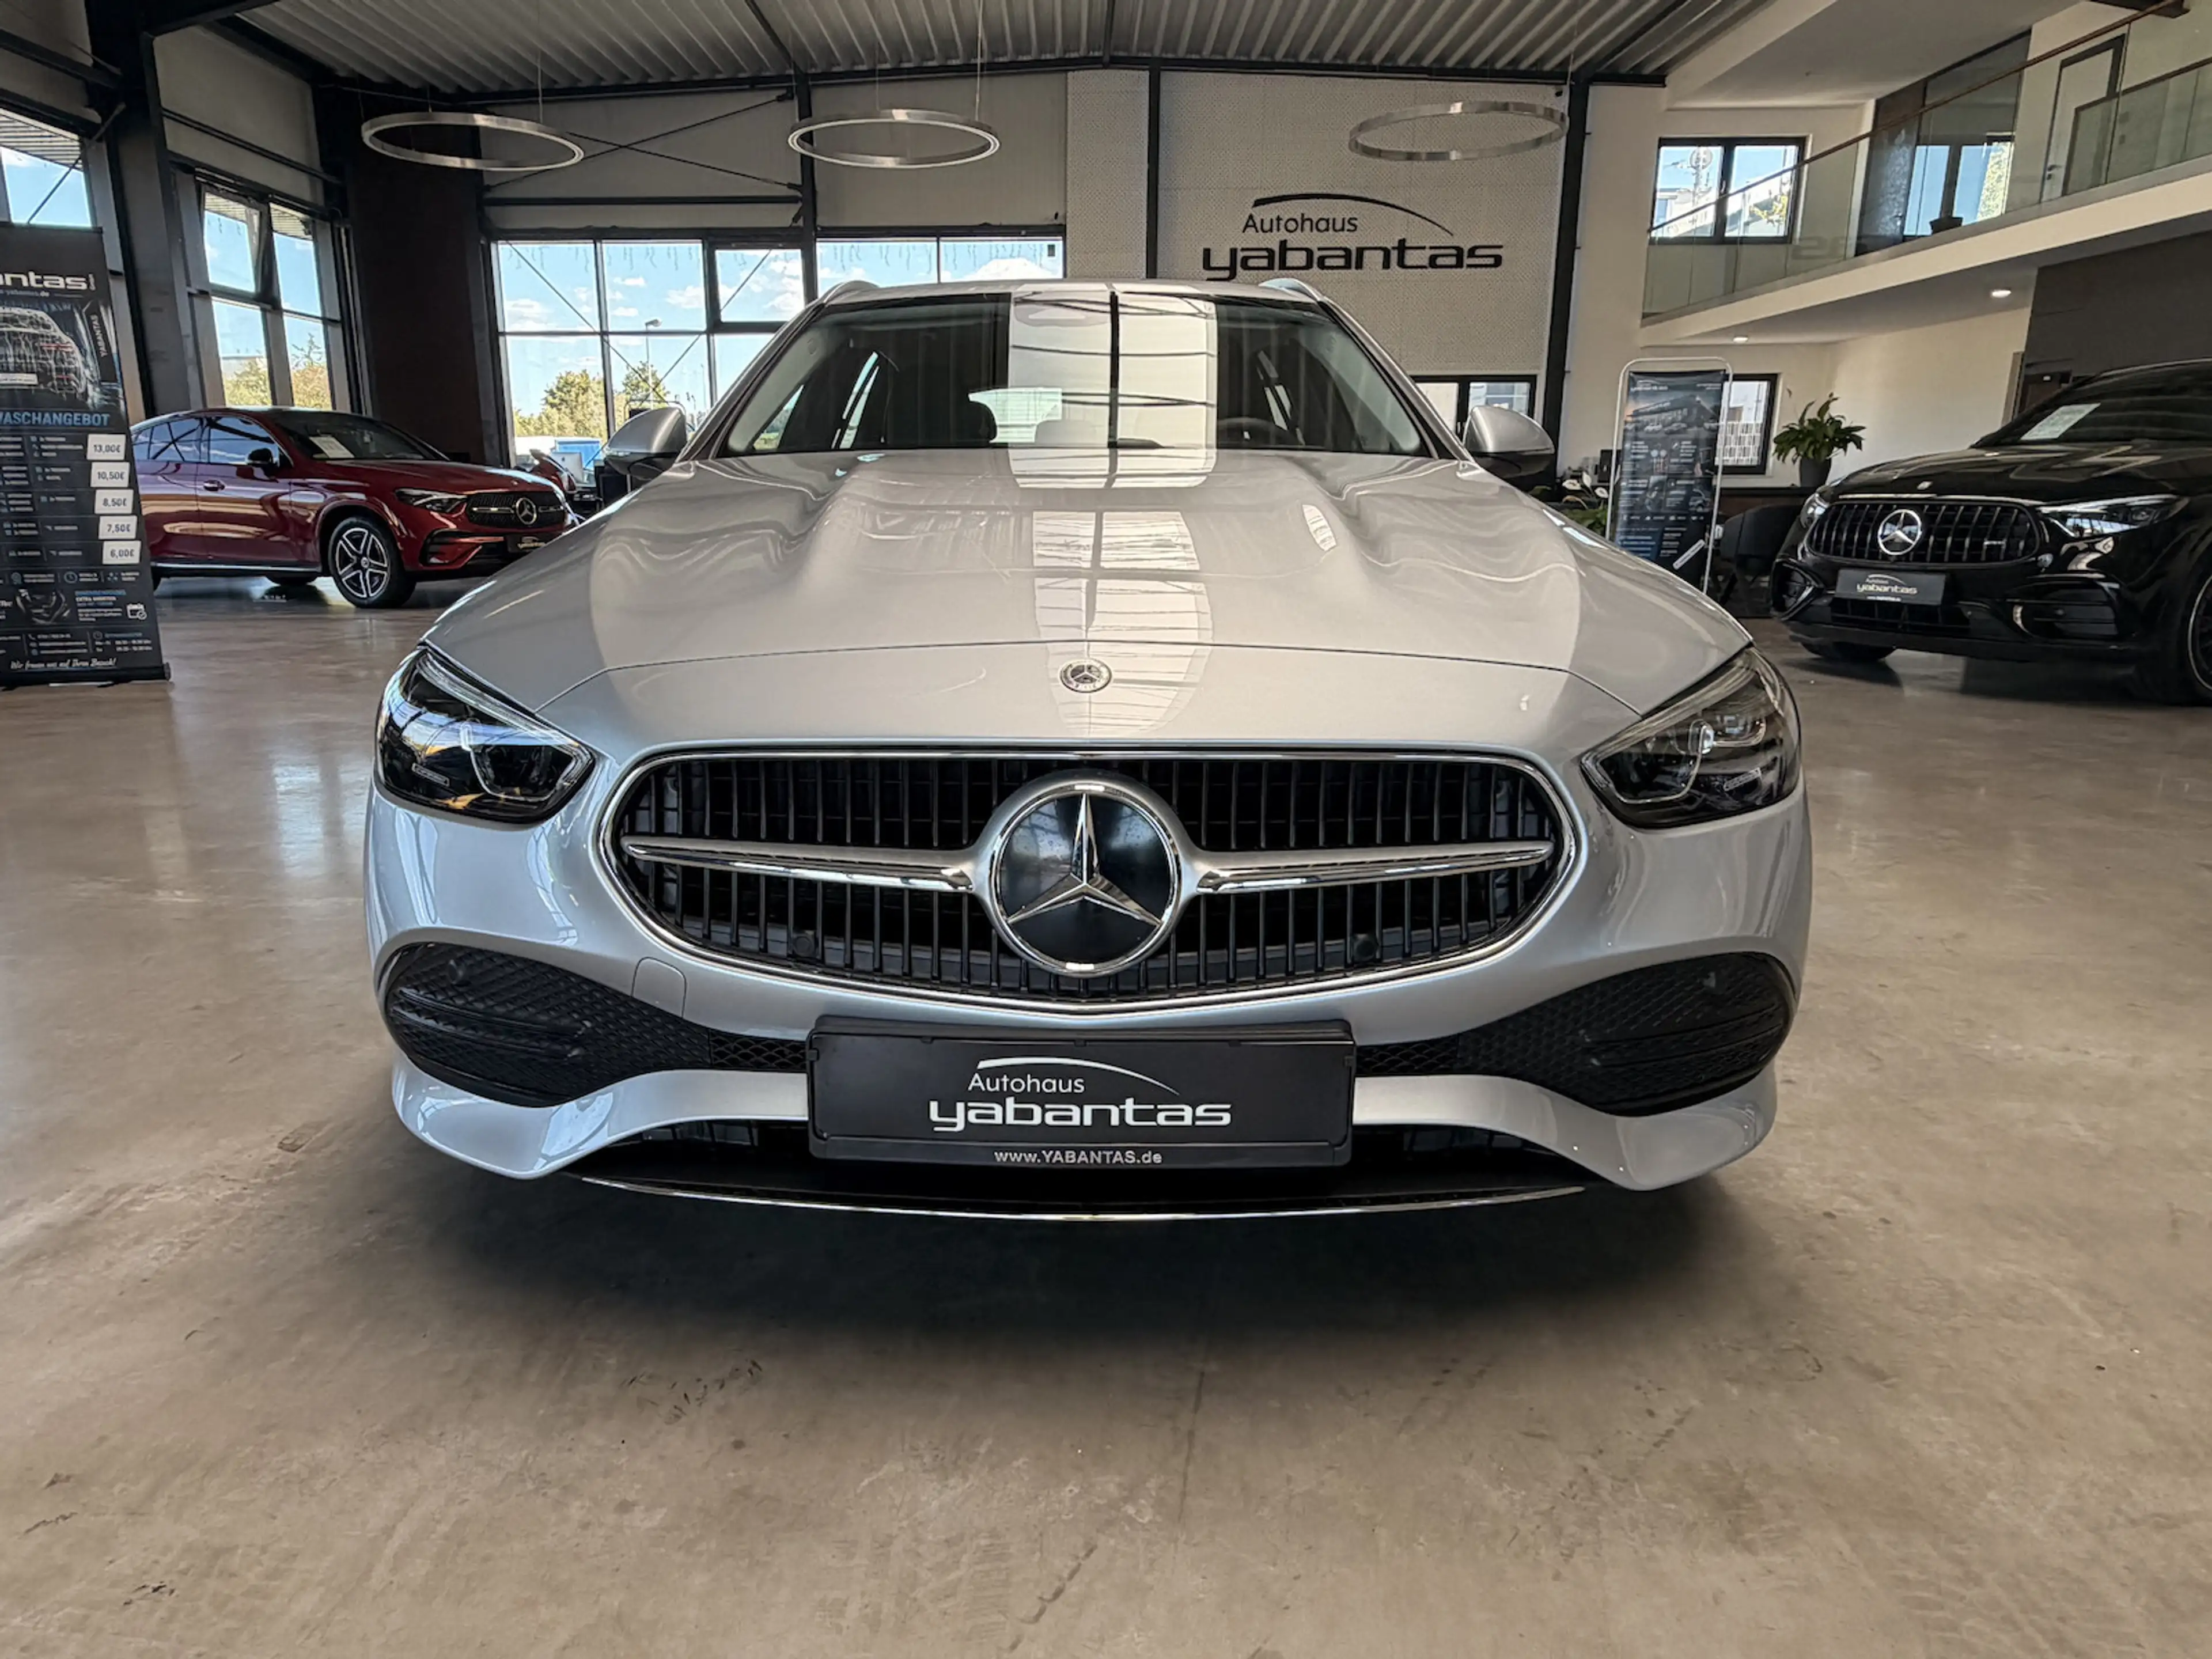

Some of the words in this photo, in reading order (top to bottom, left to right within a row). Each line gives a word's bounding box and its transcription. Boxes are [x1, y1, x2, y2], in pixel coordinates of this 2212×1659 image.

[1243, 213, 1358, 233] Autohaus
[1202, 237, 1503, 281] yabantas
[0, 271, 87, 290] ntas
[93, 444, 121, 454] 13,00€
[97, 471, 126, 480] 10,50€
[107, 524, 131, 533] 7,50€
[110, 549, 135, 559] 6,00€
[968, 1073, 1085, 1093] Autohaus
[929, 1096, 1232, 1132] yabantas
[994, 1150, 1163, 1164] www.YABANTAS.de
